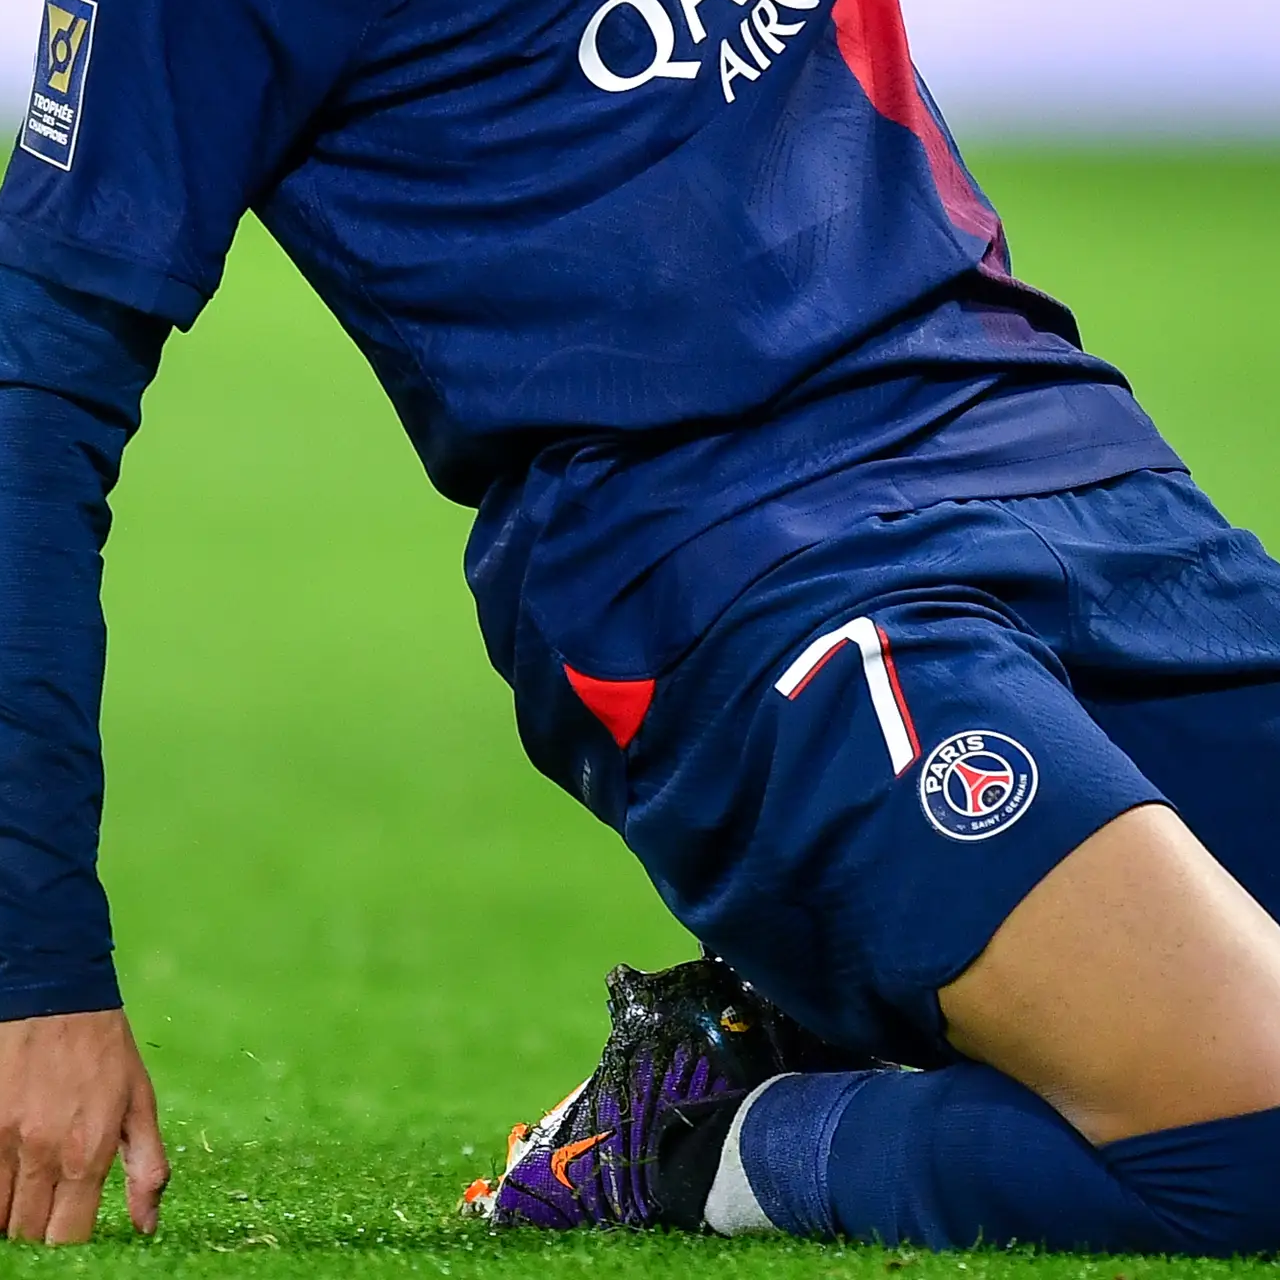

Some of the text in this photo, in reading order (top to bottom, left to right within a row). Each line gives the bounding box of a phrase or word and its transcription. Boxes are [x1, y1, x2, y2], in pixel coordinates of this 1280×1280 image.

[33, 92, 75, 124] TROPHÉE
[28, 117, 68, 146] CHAMPIONS
[774, 616, 921, 779] 7
[926, 735, 985, 794] PARIS
